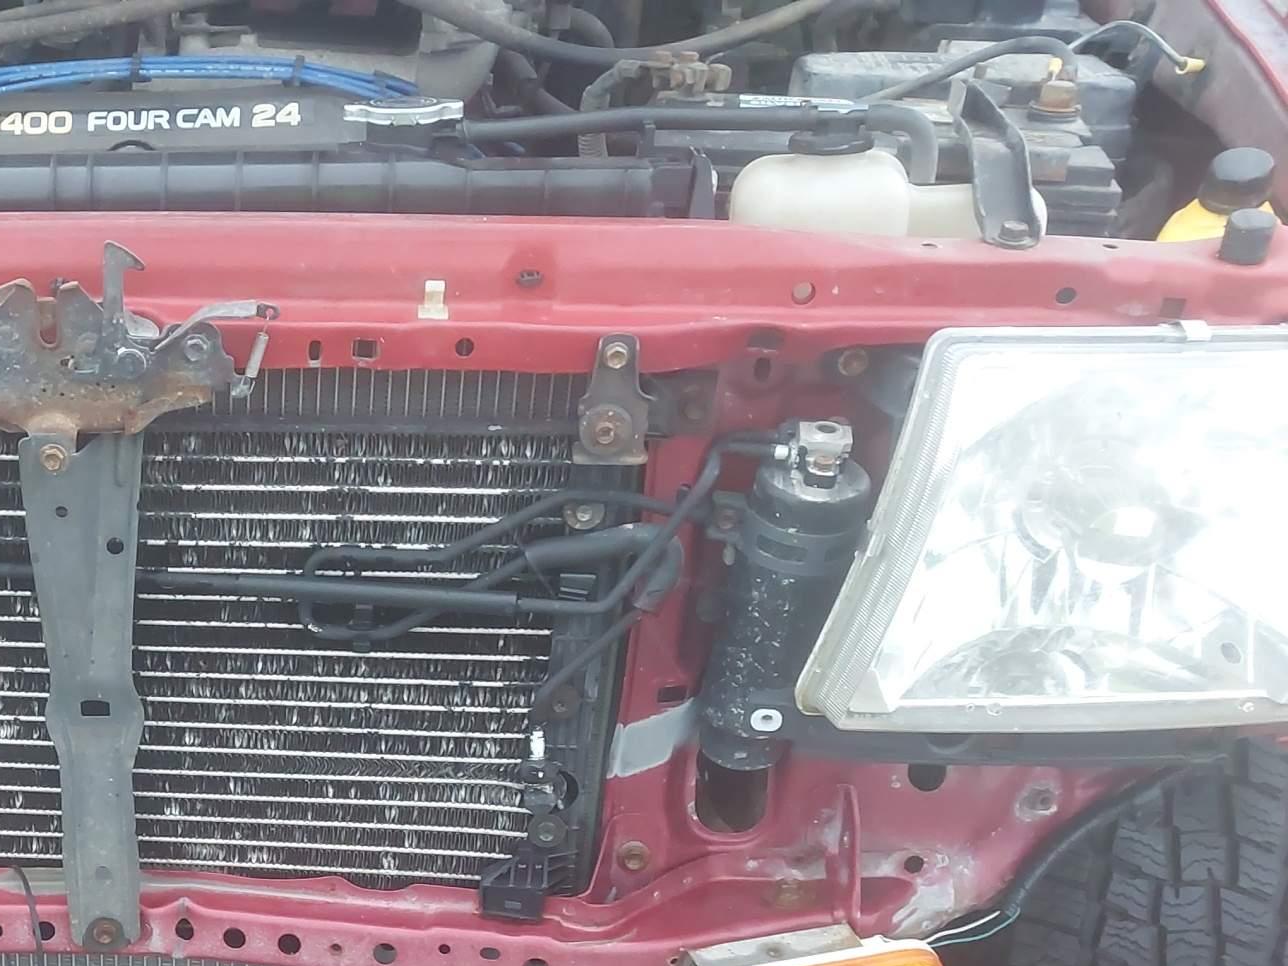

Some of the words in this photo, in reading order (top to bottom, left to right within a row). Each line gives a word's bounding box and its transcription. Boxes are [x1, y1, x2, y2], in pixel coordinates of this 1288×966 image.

[87, 109, 171, 132] FOUR
[175, 106, 241, 129] CAM
[251, 102, 301, 128] 24
